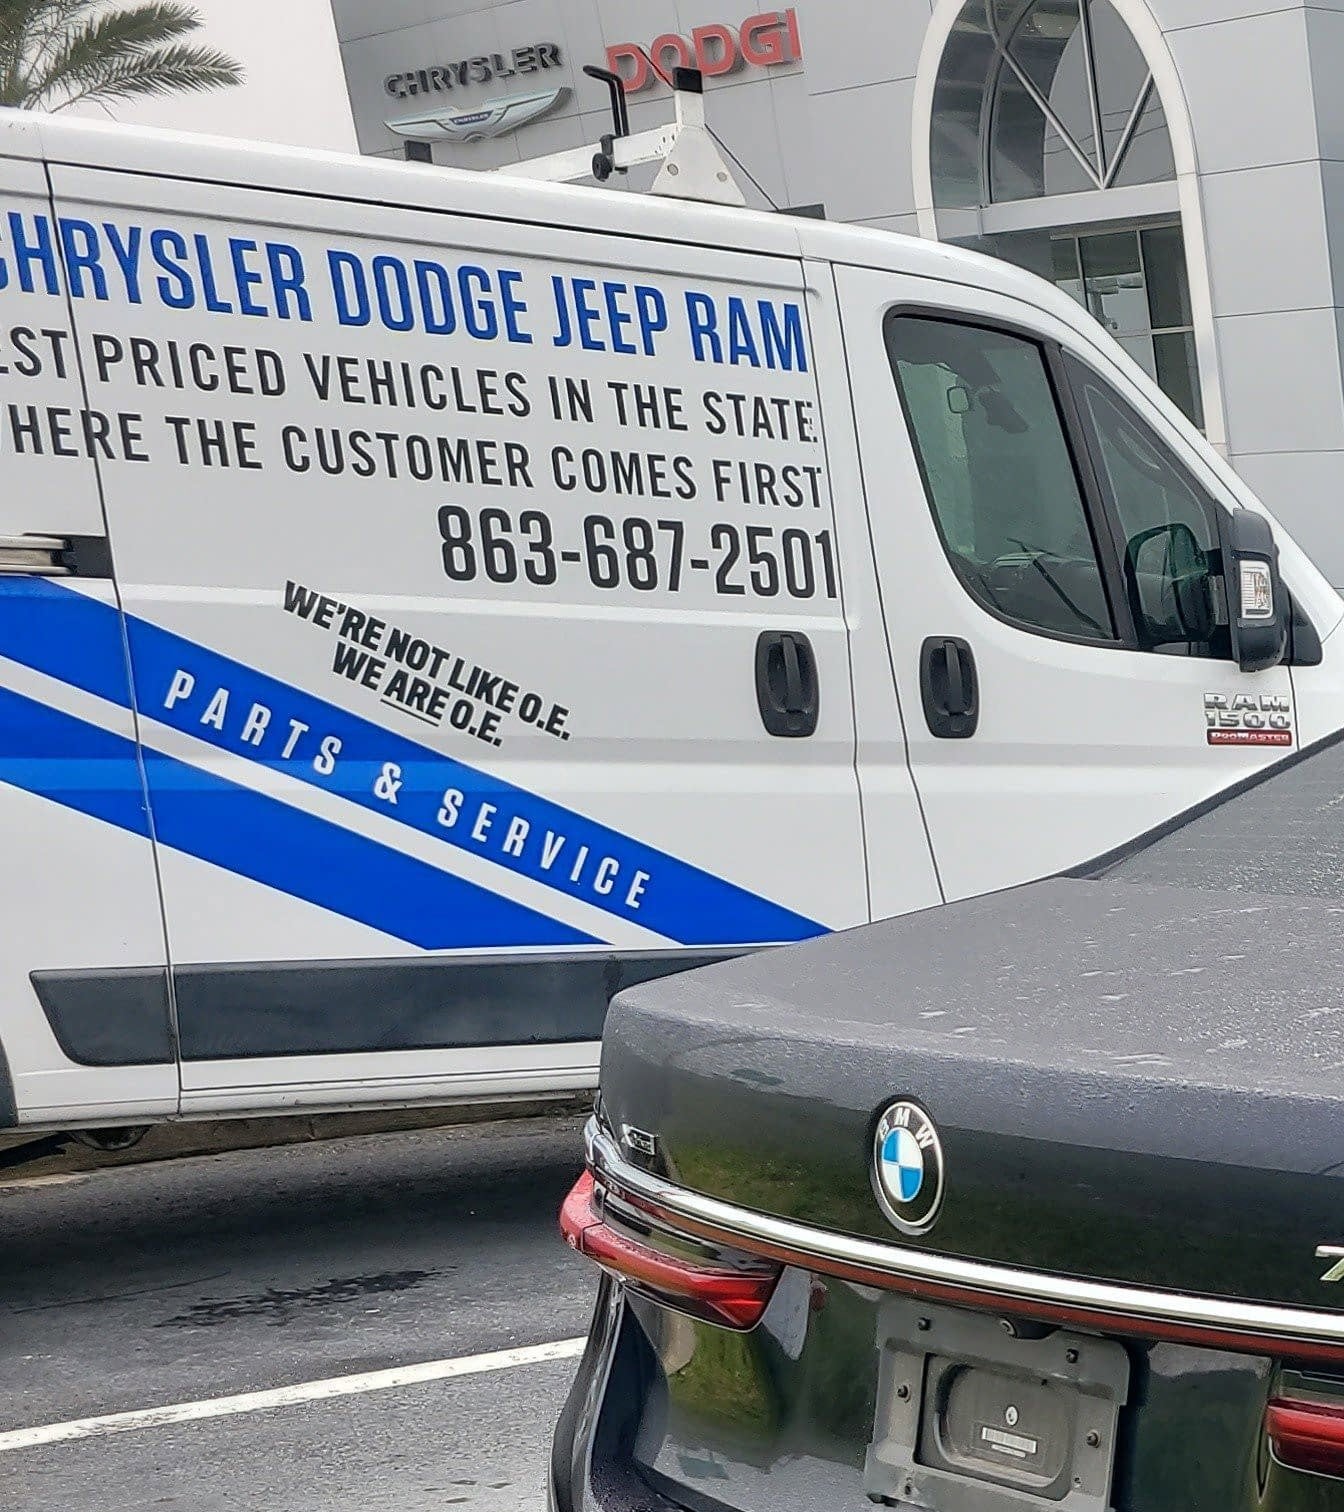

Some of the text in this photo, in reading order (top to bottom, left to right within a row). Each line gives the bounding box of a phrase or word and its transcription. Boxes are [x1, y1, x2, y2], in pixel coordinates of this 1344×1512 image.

[383, 42, 565, 99] CHRYSLER
[327, 250, 534, 344] DODGE
[552, 275, 669, 357] JEEP
[685, 291, 808, 373] RAM
[0, 326, 818, 442] ST PRICED VEHICLES IN THE STATE
[8, 404, 822, 508] HERE THE CUSTOMER COMES FIRST
[438, 505, 838, 600] 863-687-2501
[282, 580, 571, 741] WE'RE NOT LIKE O.E.
[332, 642, 503, 748] WE ARE O.E.
[1203, 693, 1290, 712] RAM
[1204, 710, 1292, 729] 1500
[163, 669, 651, 910] PARTS & SERVICE
[878, 1106, 936, 1150] BMW
